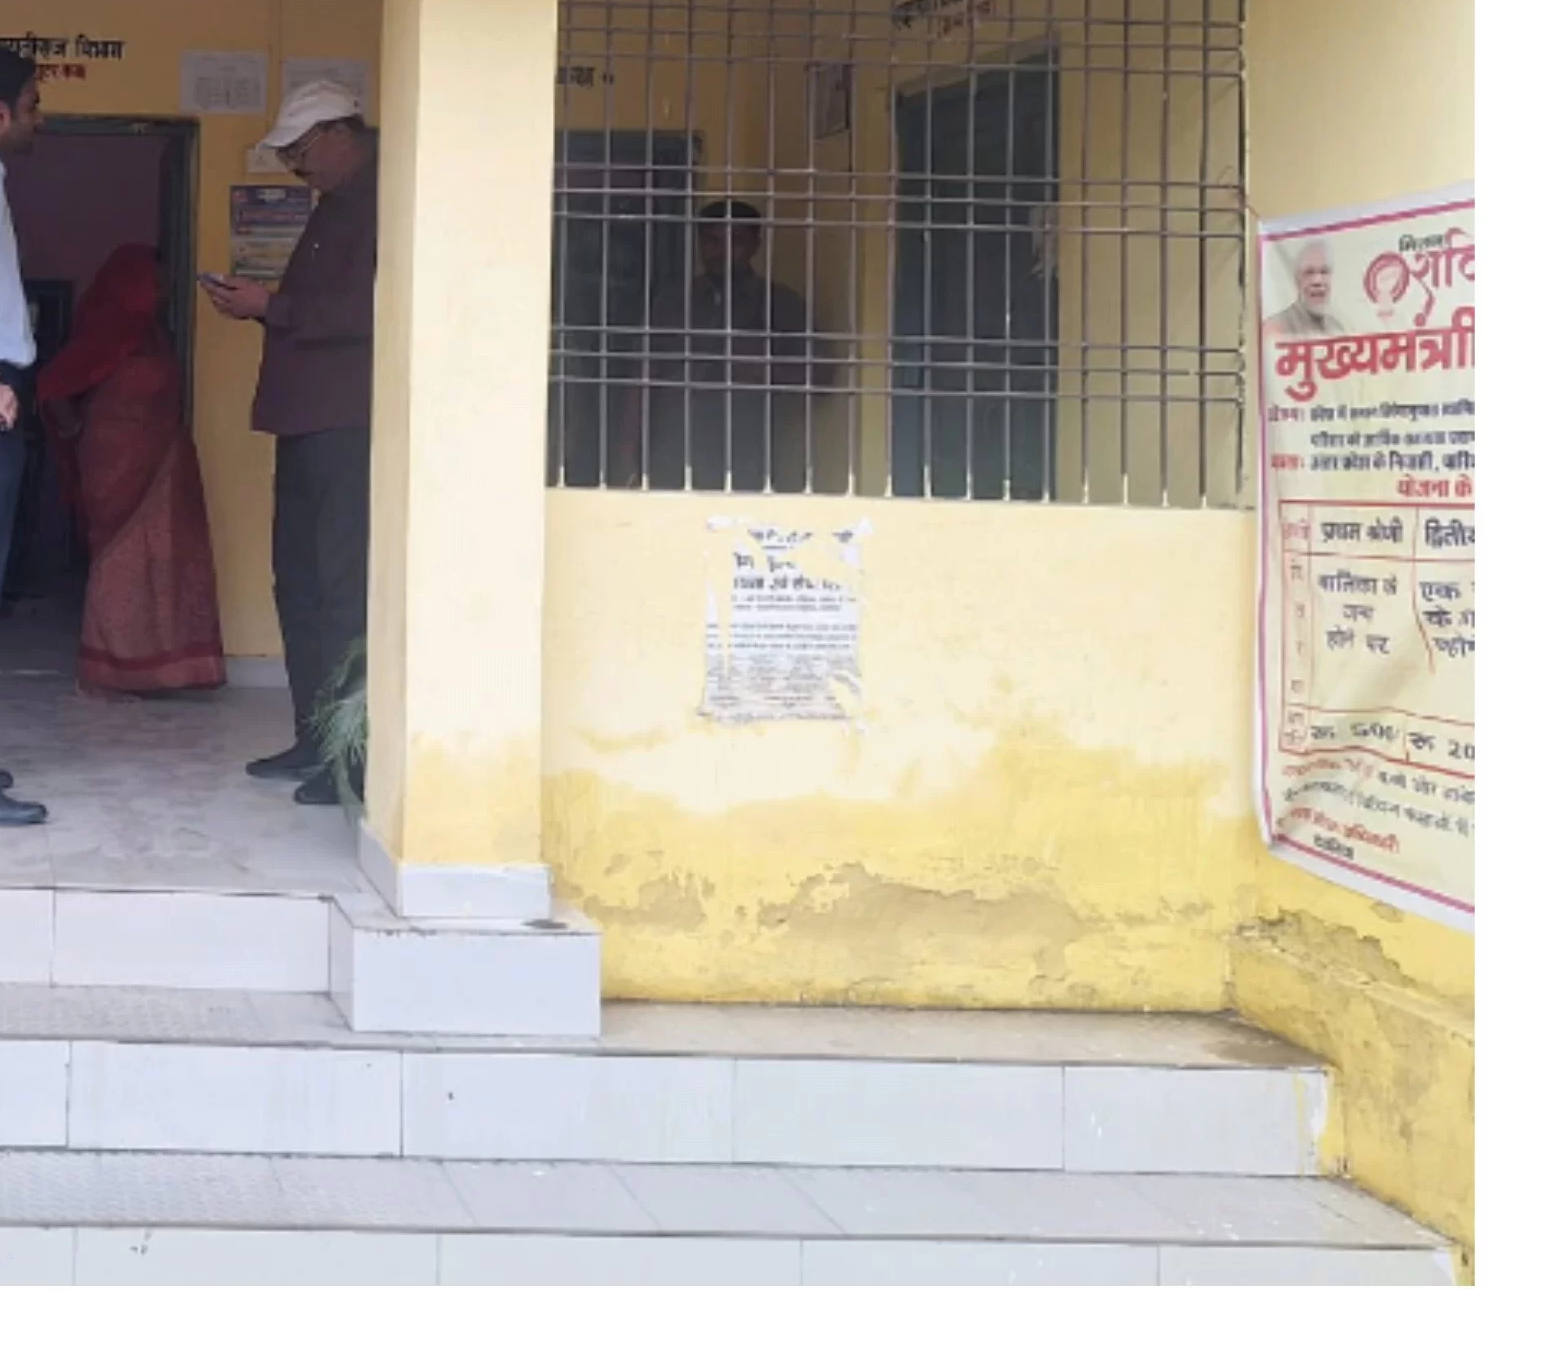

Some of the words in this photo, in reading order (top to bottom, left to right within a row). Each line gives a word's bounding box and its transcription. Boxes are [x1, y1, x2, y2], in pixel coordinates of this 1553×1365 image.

[1397, 474, 1450, 498] योजना
[1320, 520, 1362, 544] प्रथम
[1366, 515, 1404, 545] श्रेणी
